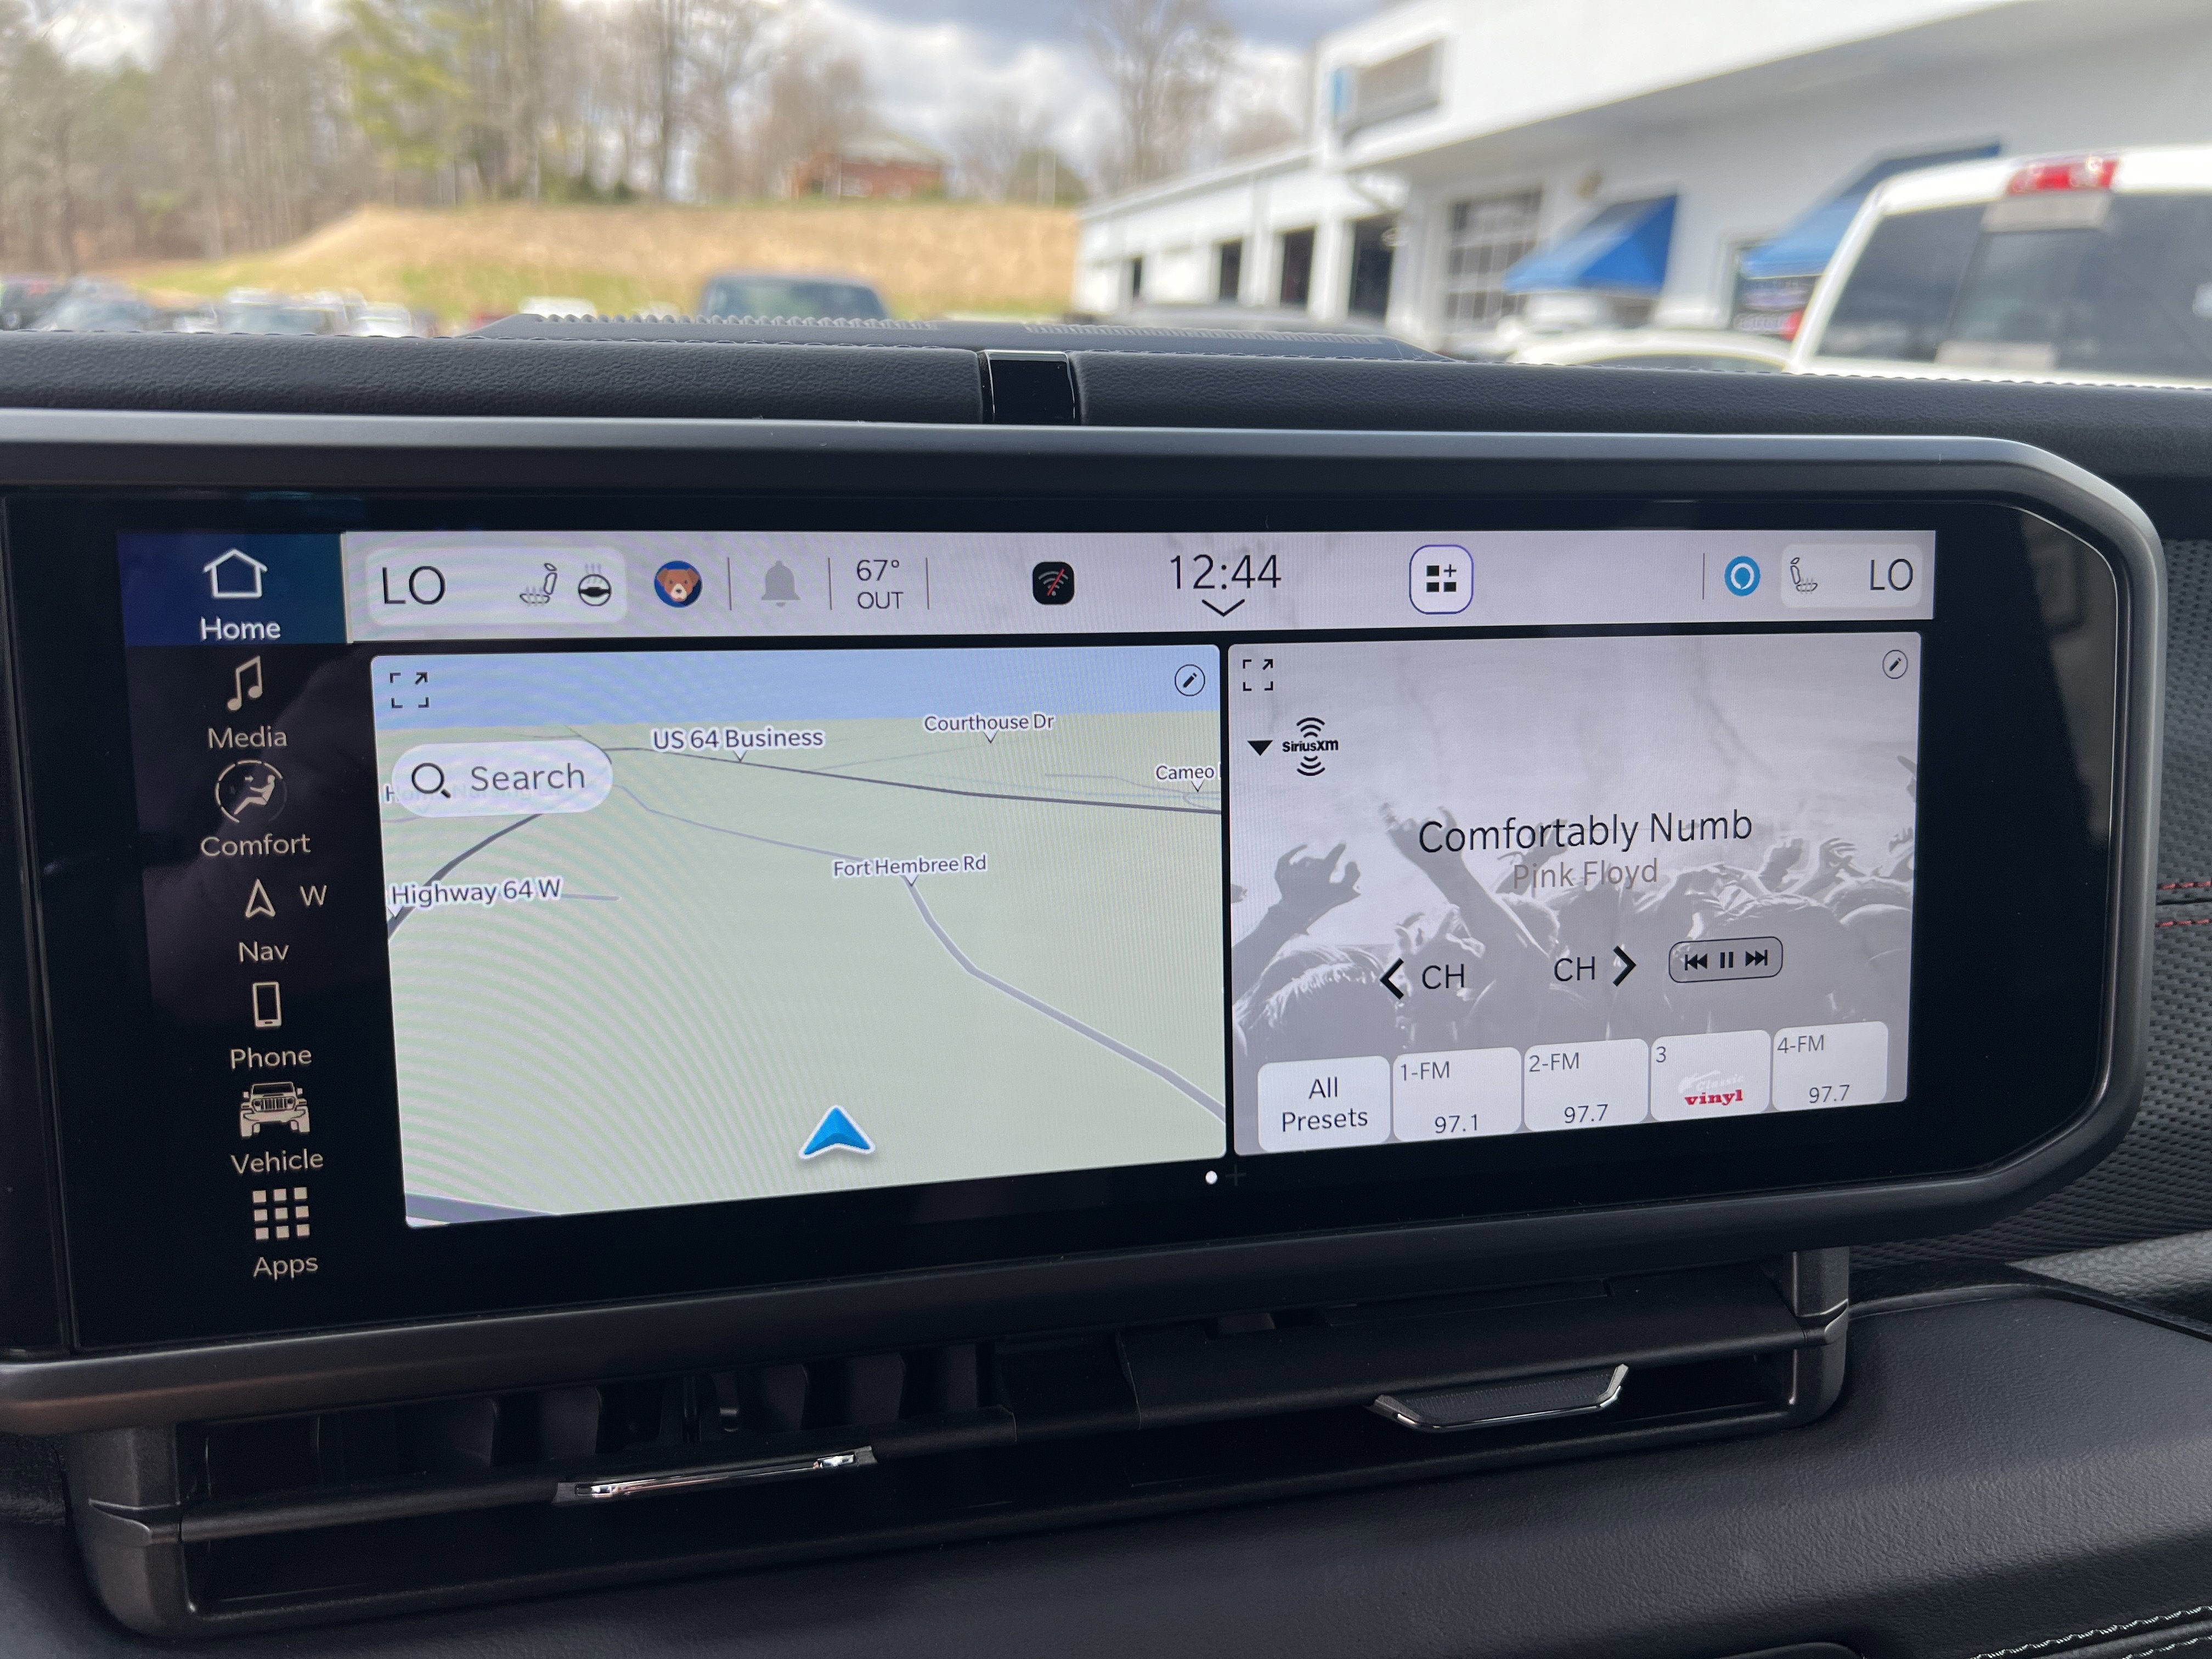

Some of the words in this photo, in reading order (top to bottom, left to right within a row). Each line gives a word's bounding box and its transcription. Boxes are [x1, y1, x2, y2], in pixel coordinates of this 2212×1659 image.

[856, 560, 900, 582] 67°
[1171, 554, 1282, 590] 12:44
[1870, 558, 1914, 591] LO
[382, 566, 445, 604] LO
[857, 591, 904, 610] OUT
[199, 617, 281, 641] Home
[924, 714, 1029, 732] Courthouse
[1034, 714, 1054, 730] Dr
[208, 726, 287, 749] Media
[653, 730, 684, 749] US
[690, 730, 719, 748] 64
[726, 729, 823, 748] Business
[471, 763, 586, 791] Search
[1155, 765, 1215, 780] Cameo
[1419, 814, 1639, 853] Comfortably
[1650, 809, 1752, 843] Numb
[201, 834, 311, 856] Comfort
[834, 862, 870, 876] Fort
[876, 857, 958, 874] Hembree
[963, 856, 986, 871] Rd
[1514, 862, 1574, 889] Pink
[1584, 857, 1658, 889] Floyd
[300, 885, 327, 907] W
[393, 883, 496, 910] Highway
[504, 881, 531, 899] 64
[538, 879, 561, 898] W
[239, 941, 289, 962] Nav
[1422, 964, 1465, 989] CH
[1554, 957, 1595, 981] CH
[1656, 1046, 1666, 1063] 3
[1777, 1035, 1825, 1053] 4-FM
[230, 1048, 312, 1069] Phone
[1528, 1053, 1579, 1073] 2-FM
[1400, 1061, 1450, 1081] 1-FM
[1309, 1077, 1338, 1099] All
[1684, 1089, 1743, 1106] vinyl
[1809, 1085, 1849, 1103] 97.7
[1282, 1108, 1368, 1132] Presets
[1435, 1114, 1479, 1133] 97.1
[1564, 1104, 1608, 1124] 97.7
[231, 1149, 323, 1173] Vehicle
[253, 1256, 318, 1280] Apps
